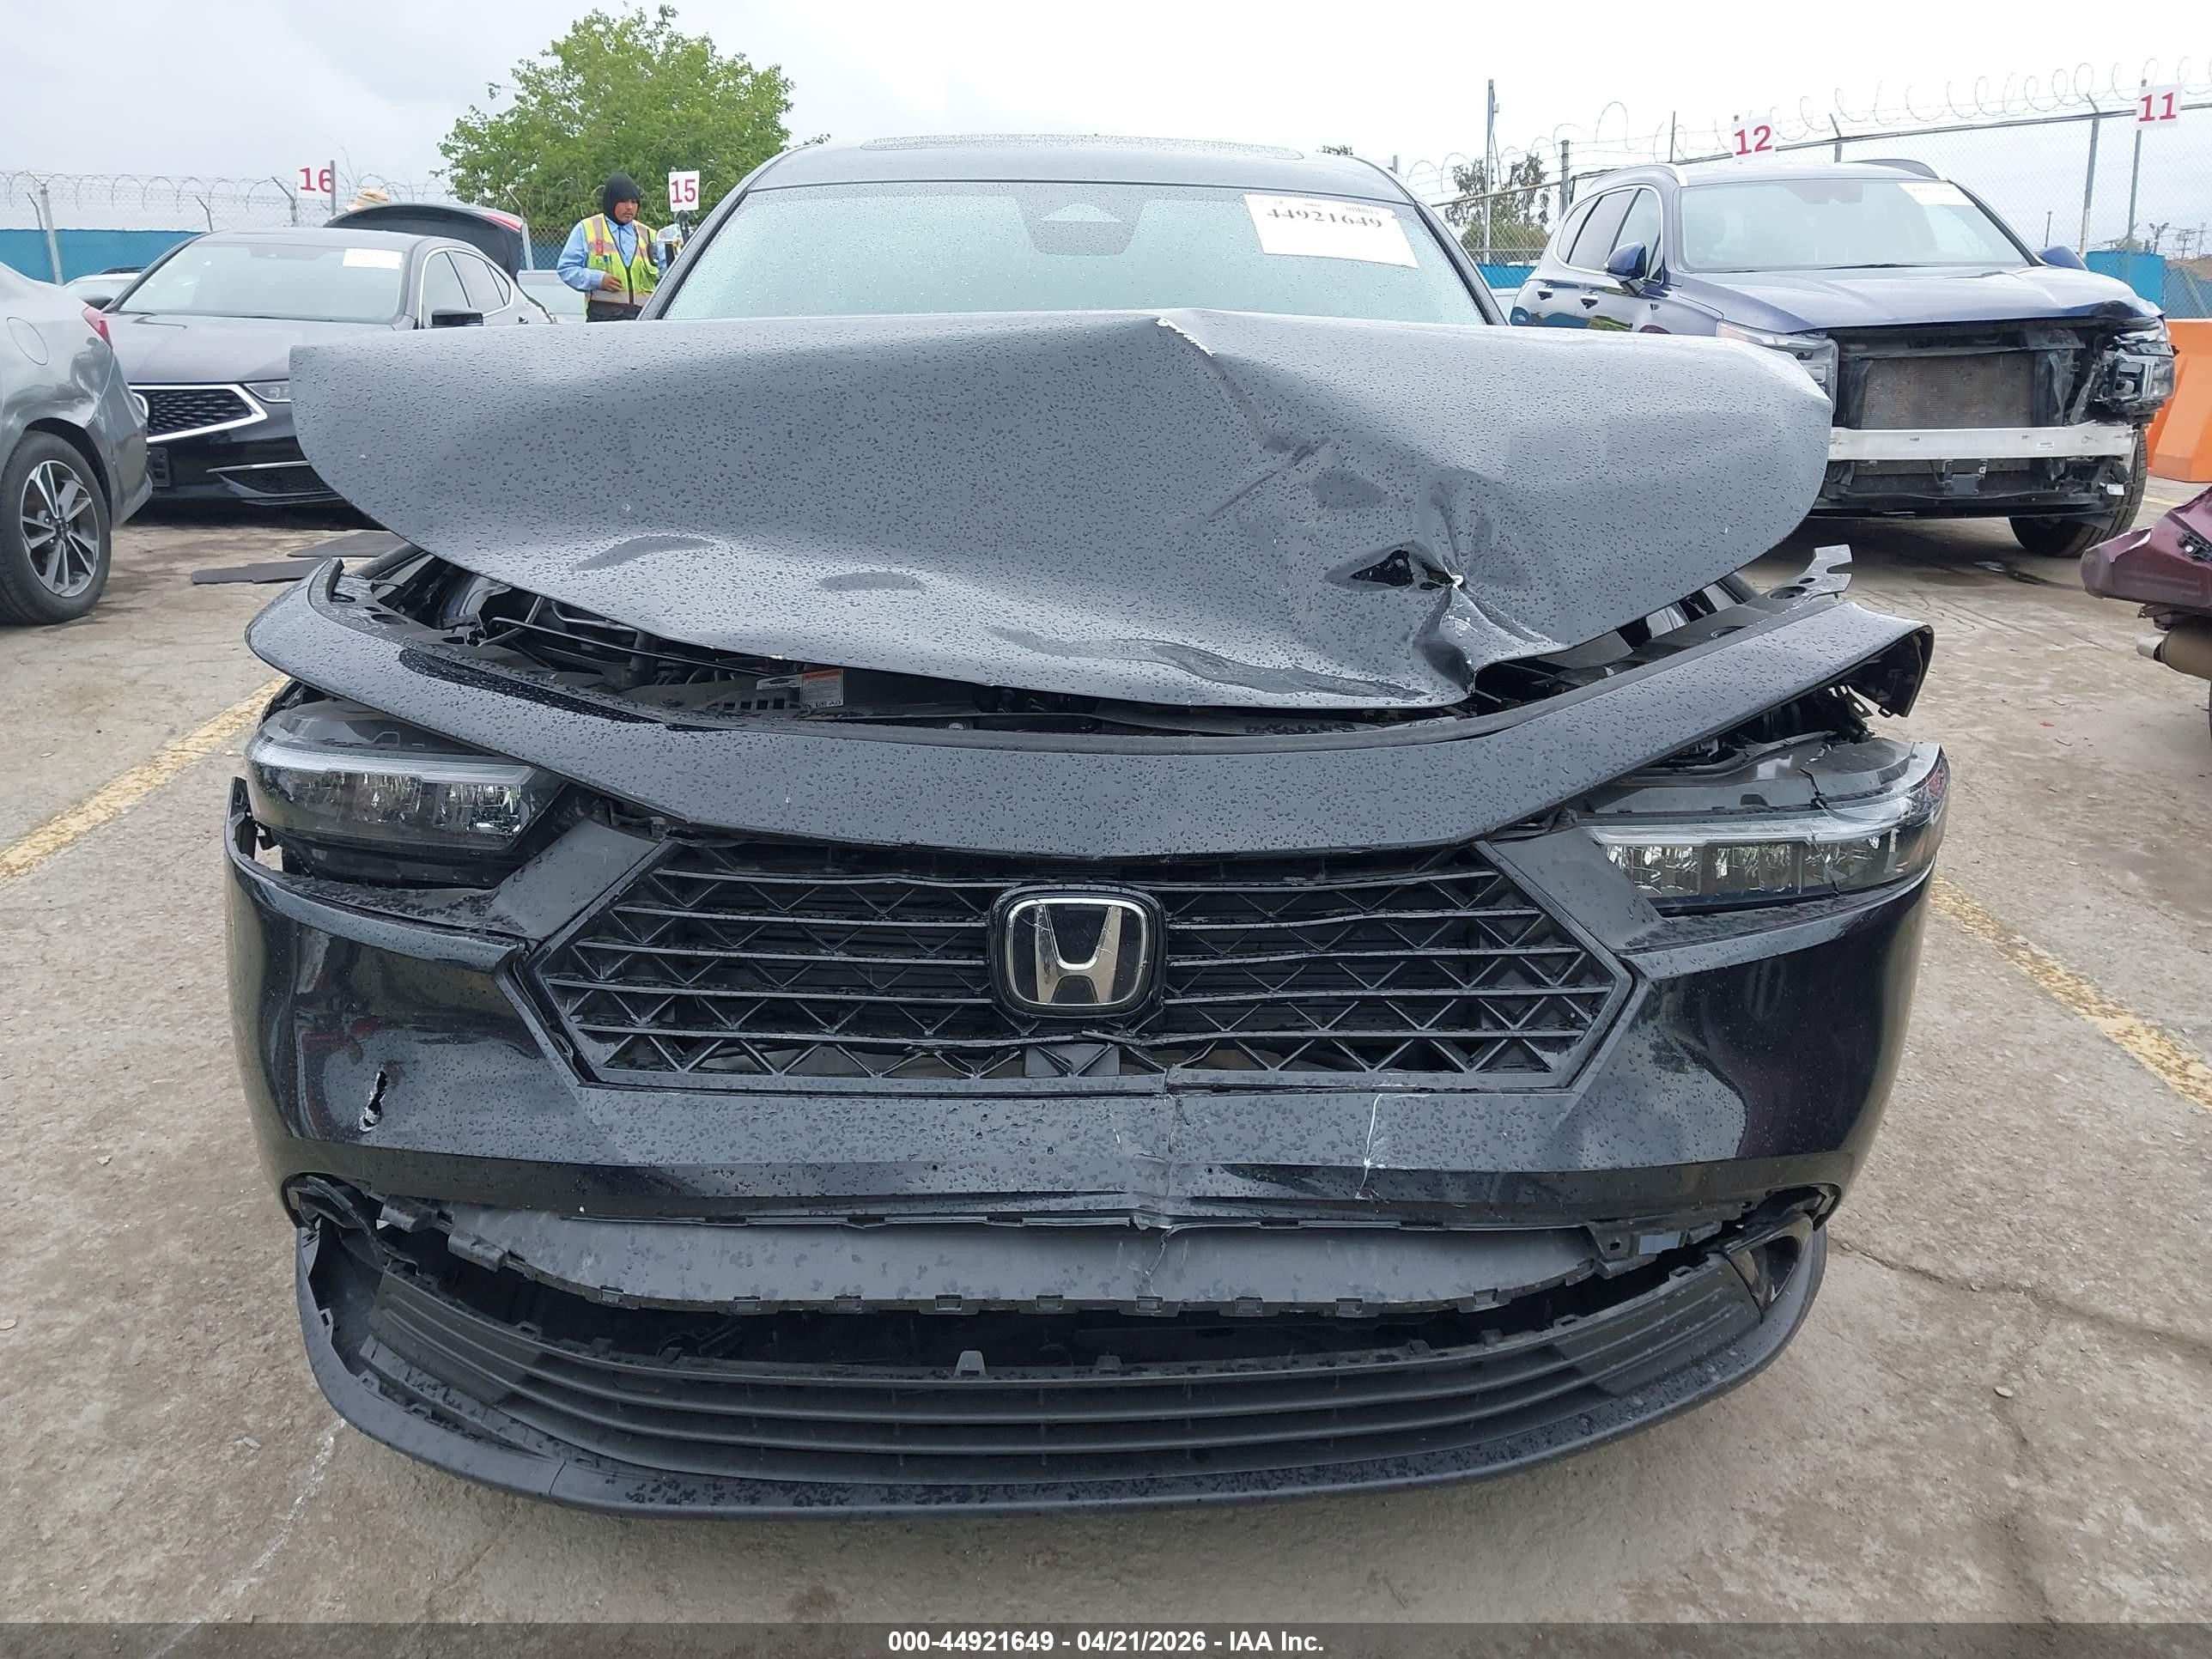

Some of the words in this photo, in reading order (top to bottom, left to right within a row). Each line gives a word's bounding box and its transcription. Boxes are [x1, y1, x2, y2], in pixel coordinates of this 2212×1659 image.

[2138, 92, 2177, 122] 11
[1734, 125, 1773, 155] 12
[299, 167, 333, 193] 16
[671, 178, 696, 204] 15
[1267, 208, 1382, 228] 44921649
